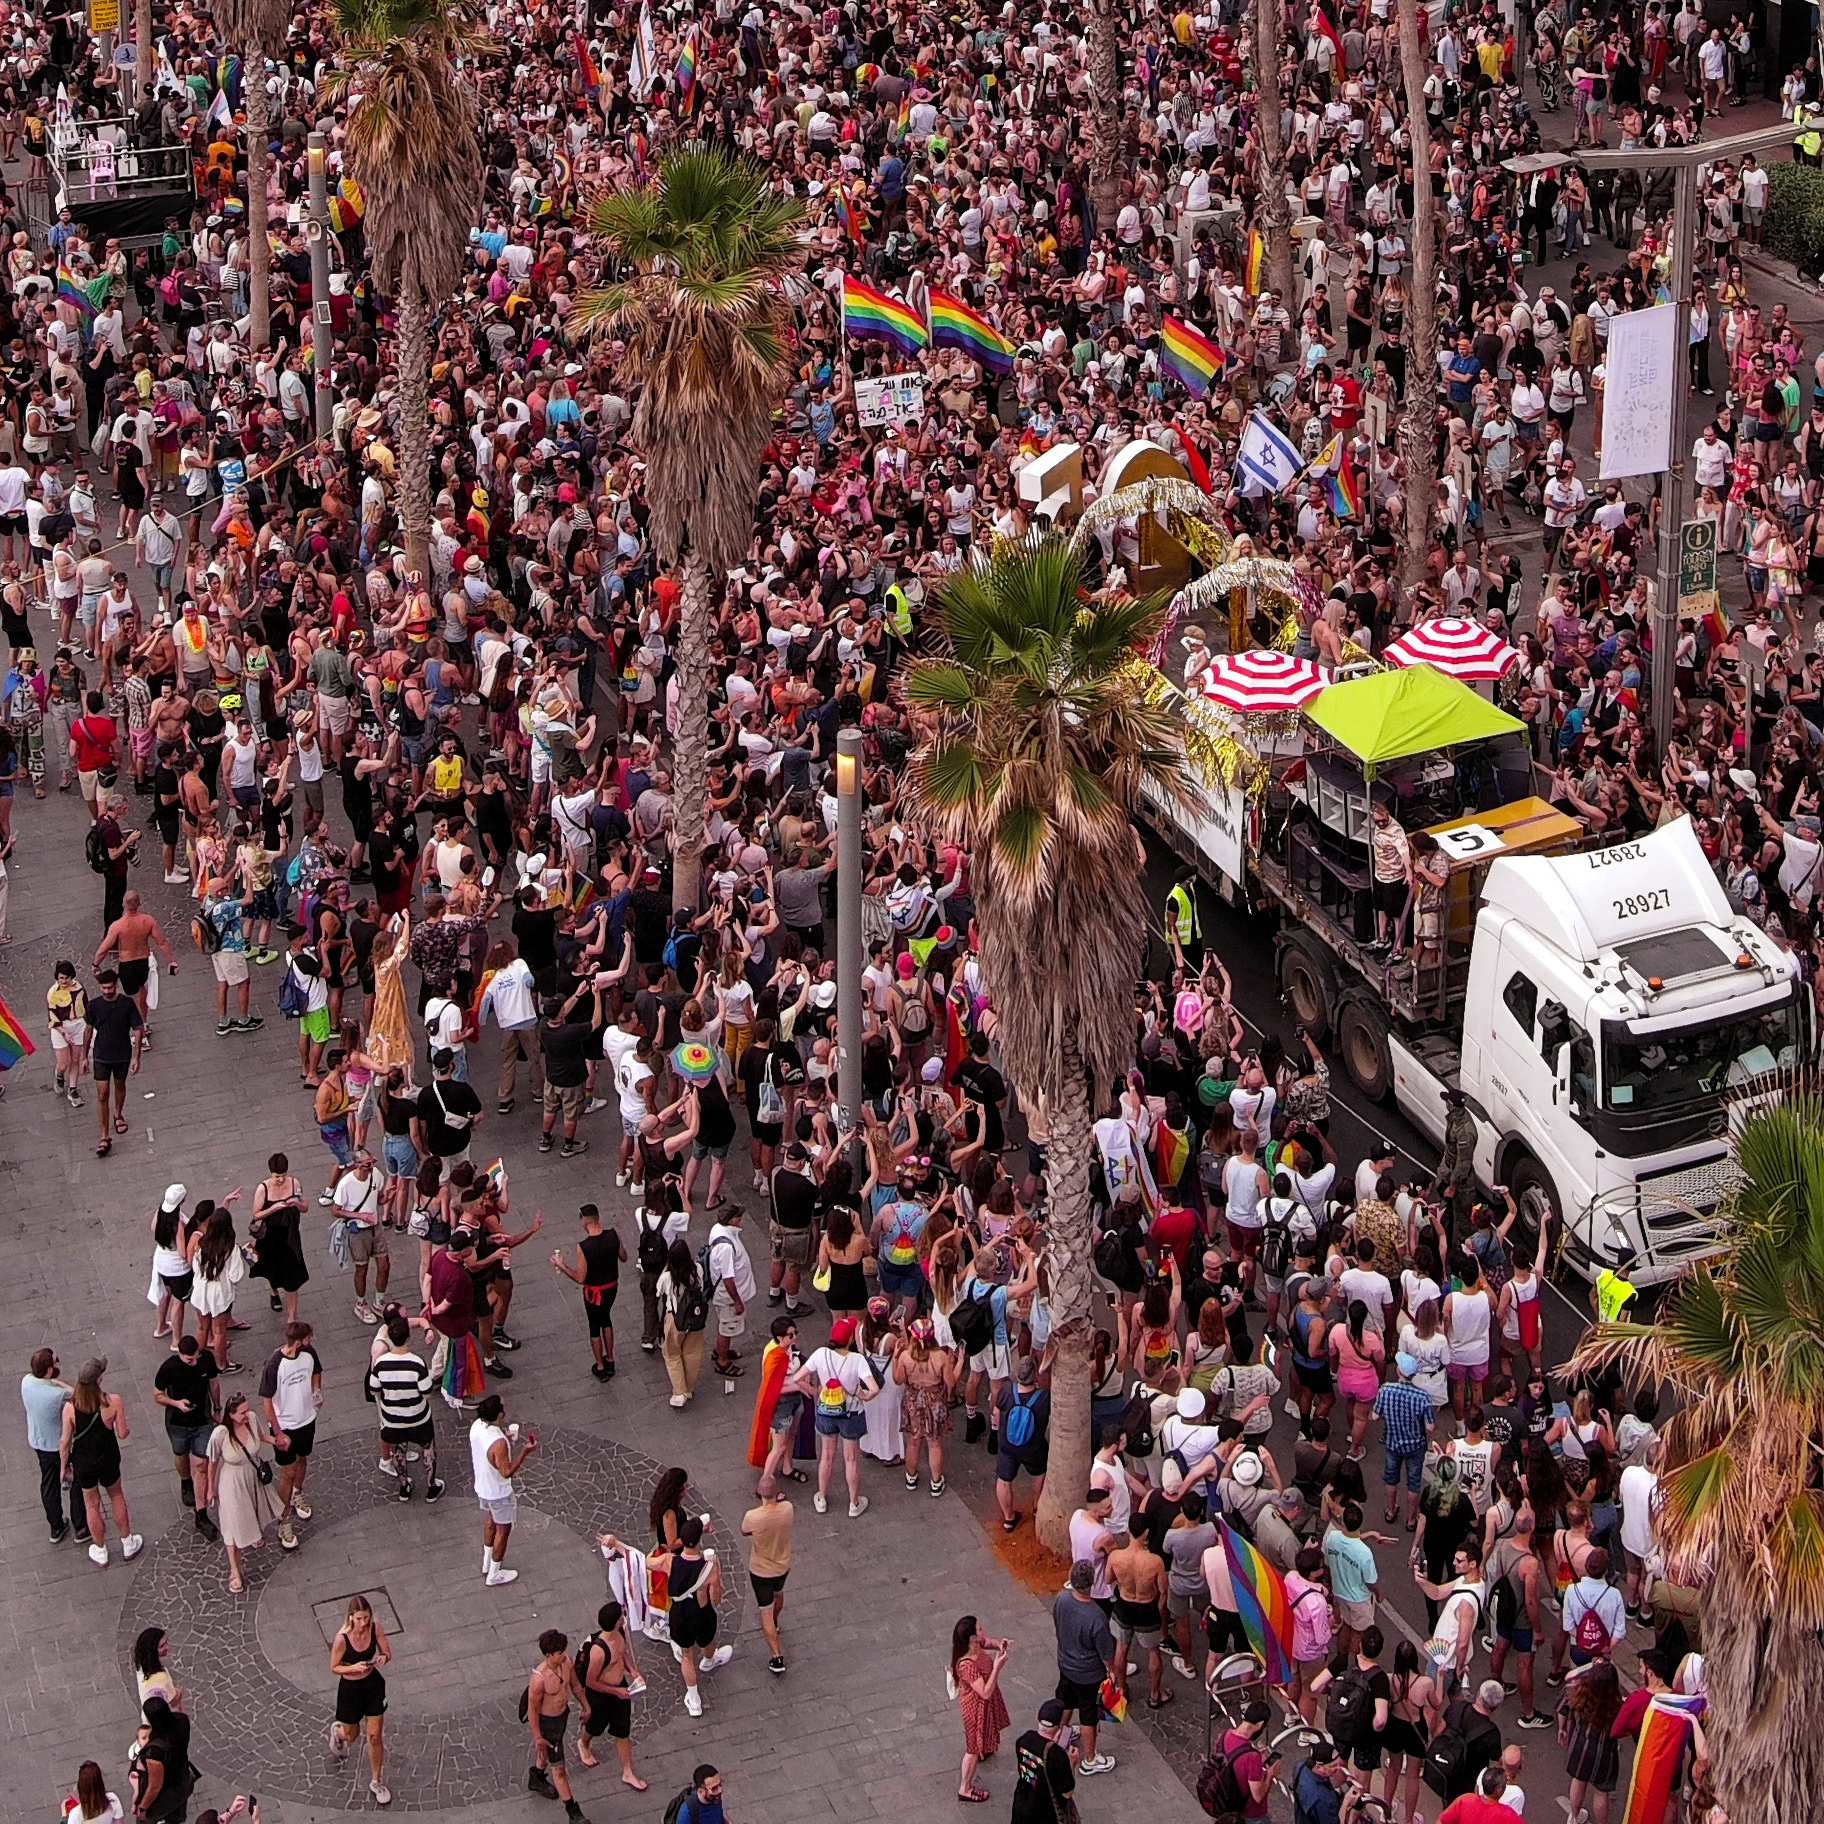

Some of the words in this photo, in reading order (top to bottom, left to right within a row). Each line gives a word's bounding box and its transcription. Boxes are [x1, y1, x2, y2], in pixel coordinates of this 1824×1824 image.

[1446, 831, 1485, 851] 5
[1587, 843, 1647, 869] 28927
[1612, 889, 1672, 920] 28927
